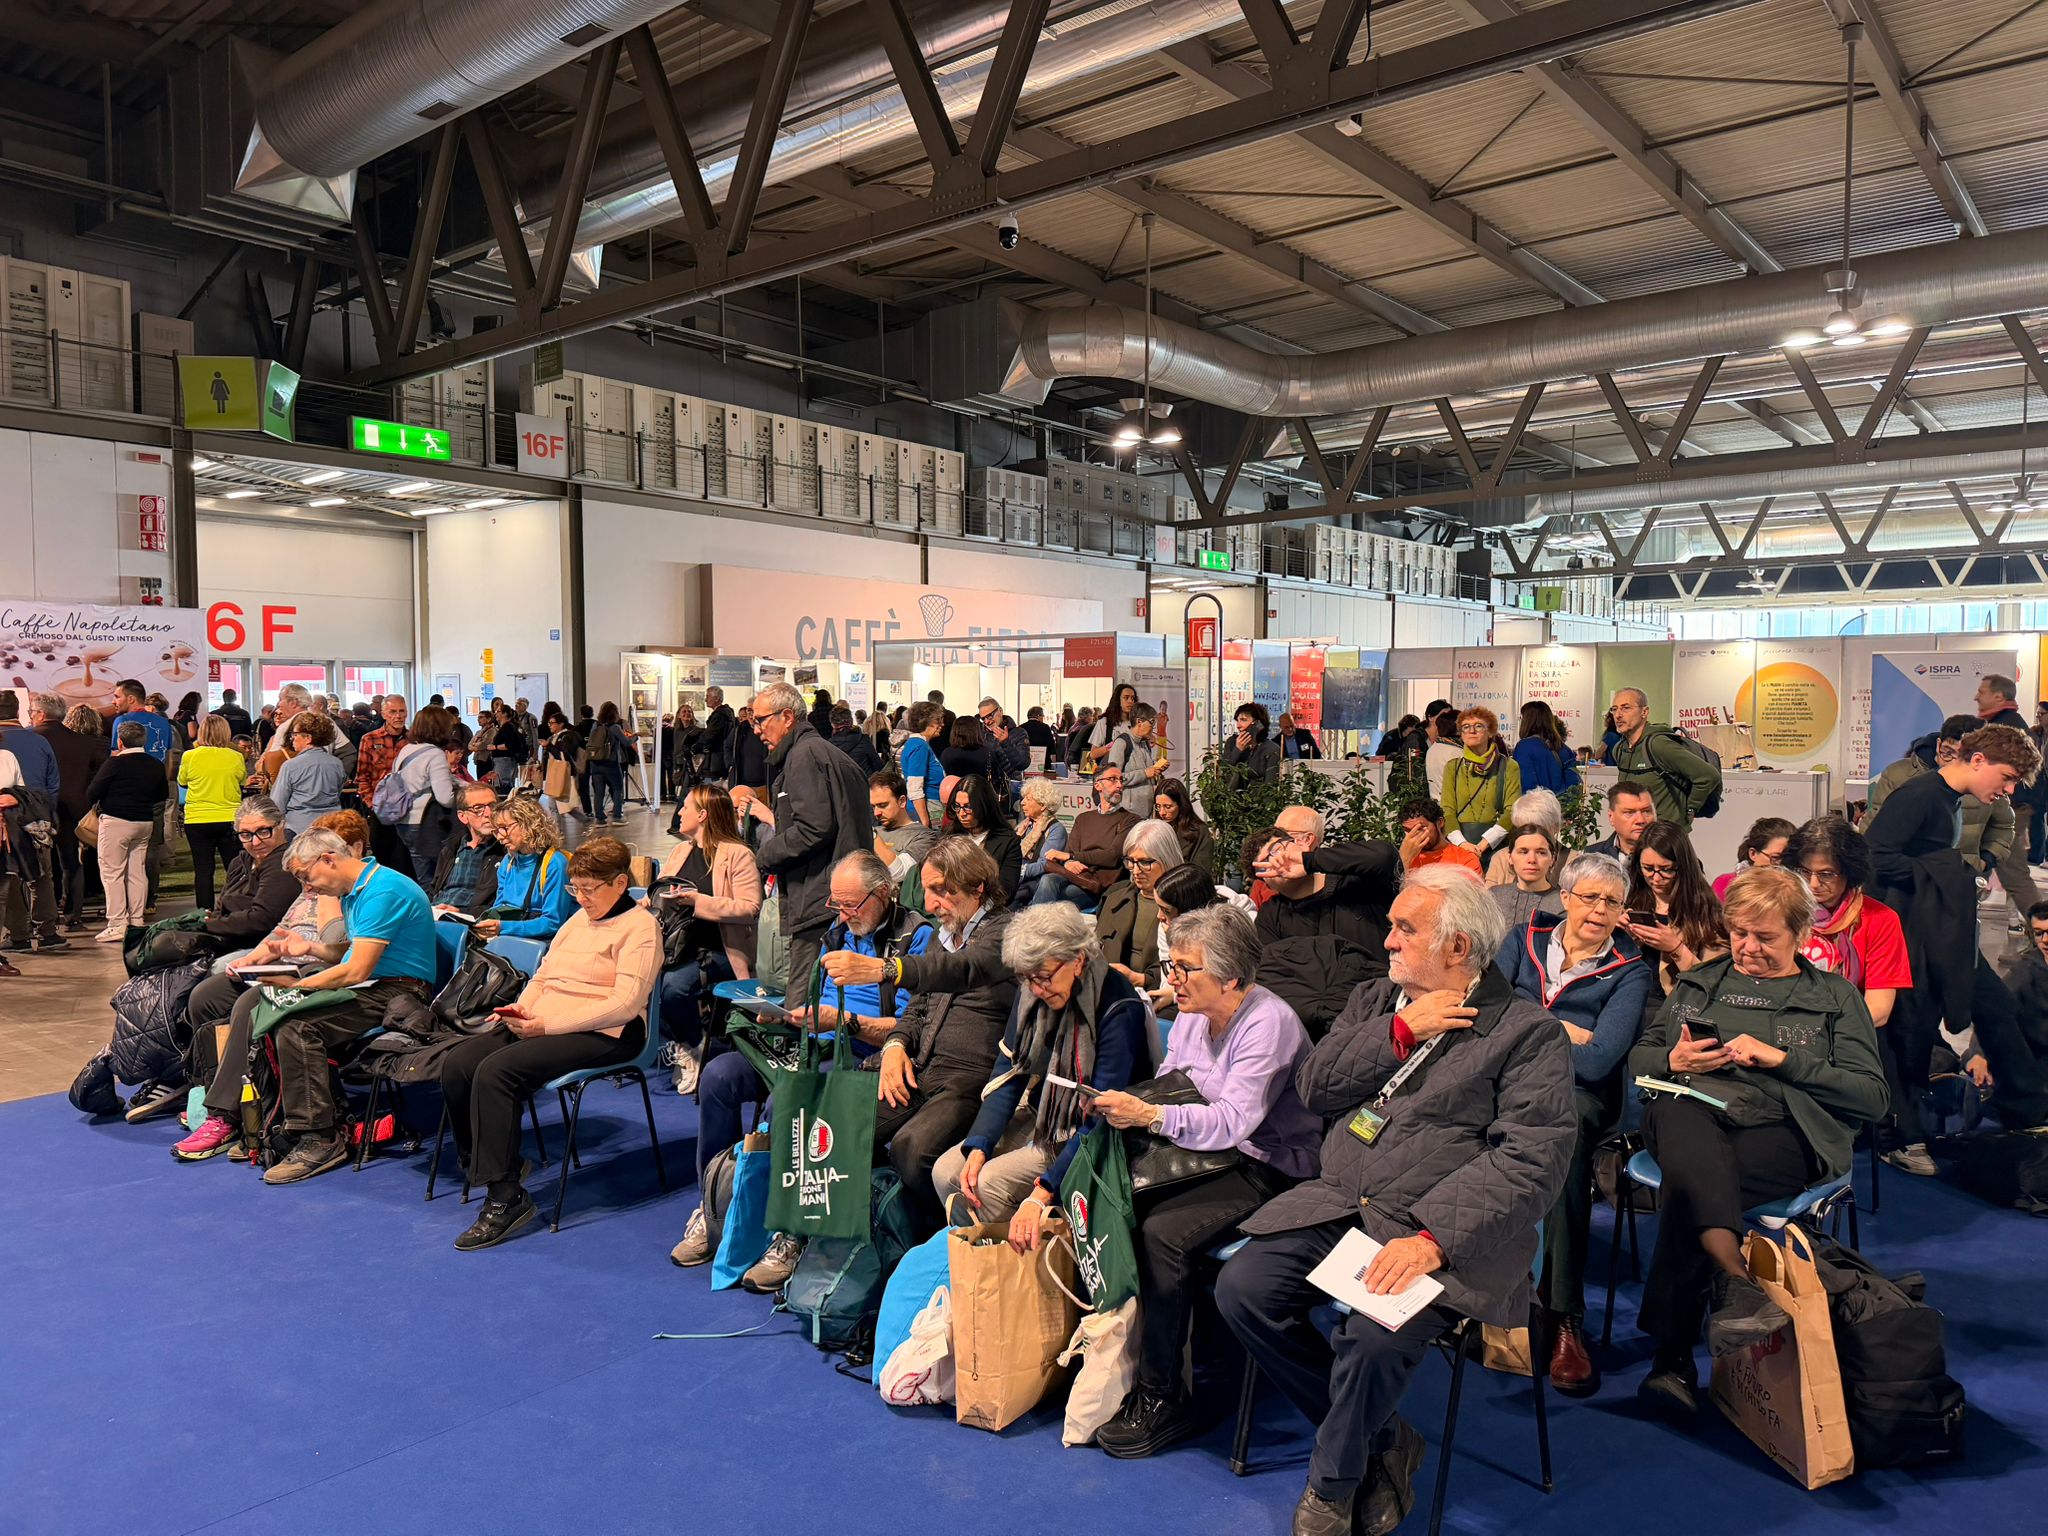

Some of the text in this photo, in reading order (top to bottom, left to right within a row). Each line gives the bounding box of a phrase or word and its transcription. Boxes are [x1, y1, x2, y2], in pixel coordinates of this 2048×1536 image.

[521, 432, 564, 459] 16F
[1, 608, 176, 635] Caffè Napoletano
[262, 605, 297, 651] F
[18, 632, 63, 641] CREMOSO
[86, 634, 114, 642] GUSTO
[1065, 659, 1104, 669] Help3 OdV
[1458, 661, 1495, 669] FACCIAMO
[1929, 665, 1961, 674] ISPRA
[1528, 690, 1569, 698] SUPERIORE
[1679, 709, 1693, 718] SAI
[1059, 796, 1092, 809] ELP3
[791, 1117, 800, 1169] LE BELLEZZE
[1743, 1366, 1772, 1401] FUTURO
[1767, 1407, 1781, 1430] FA
